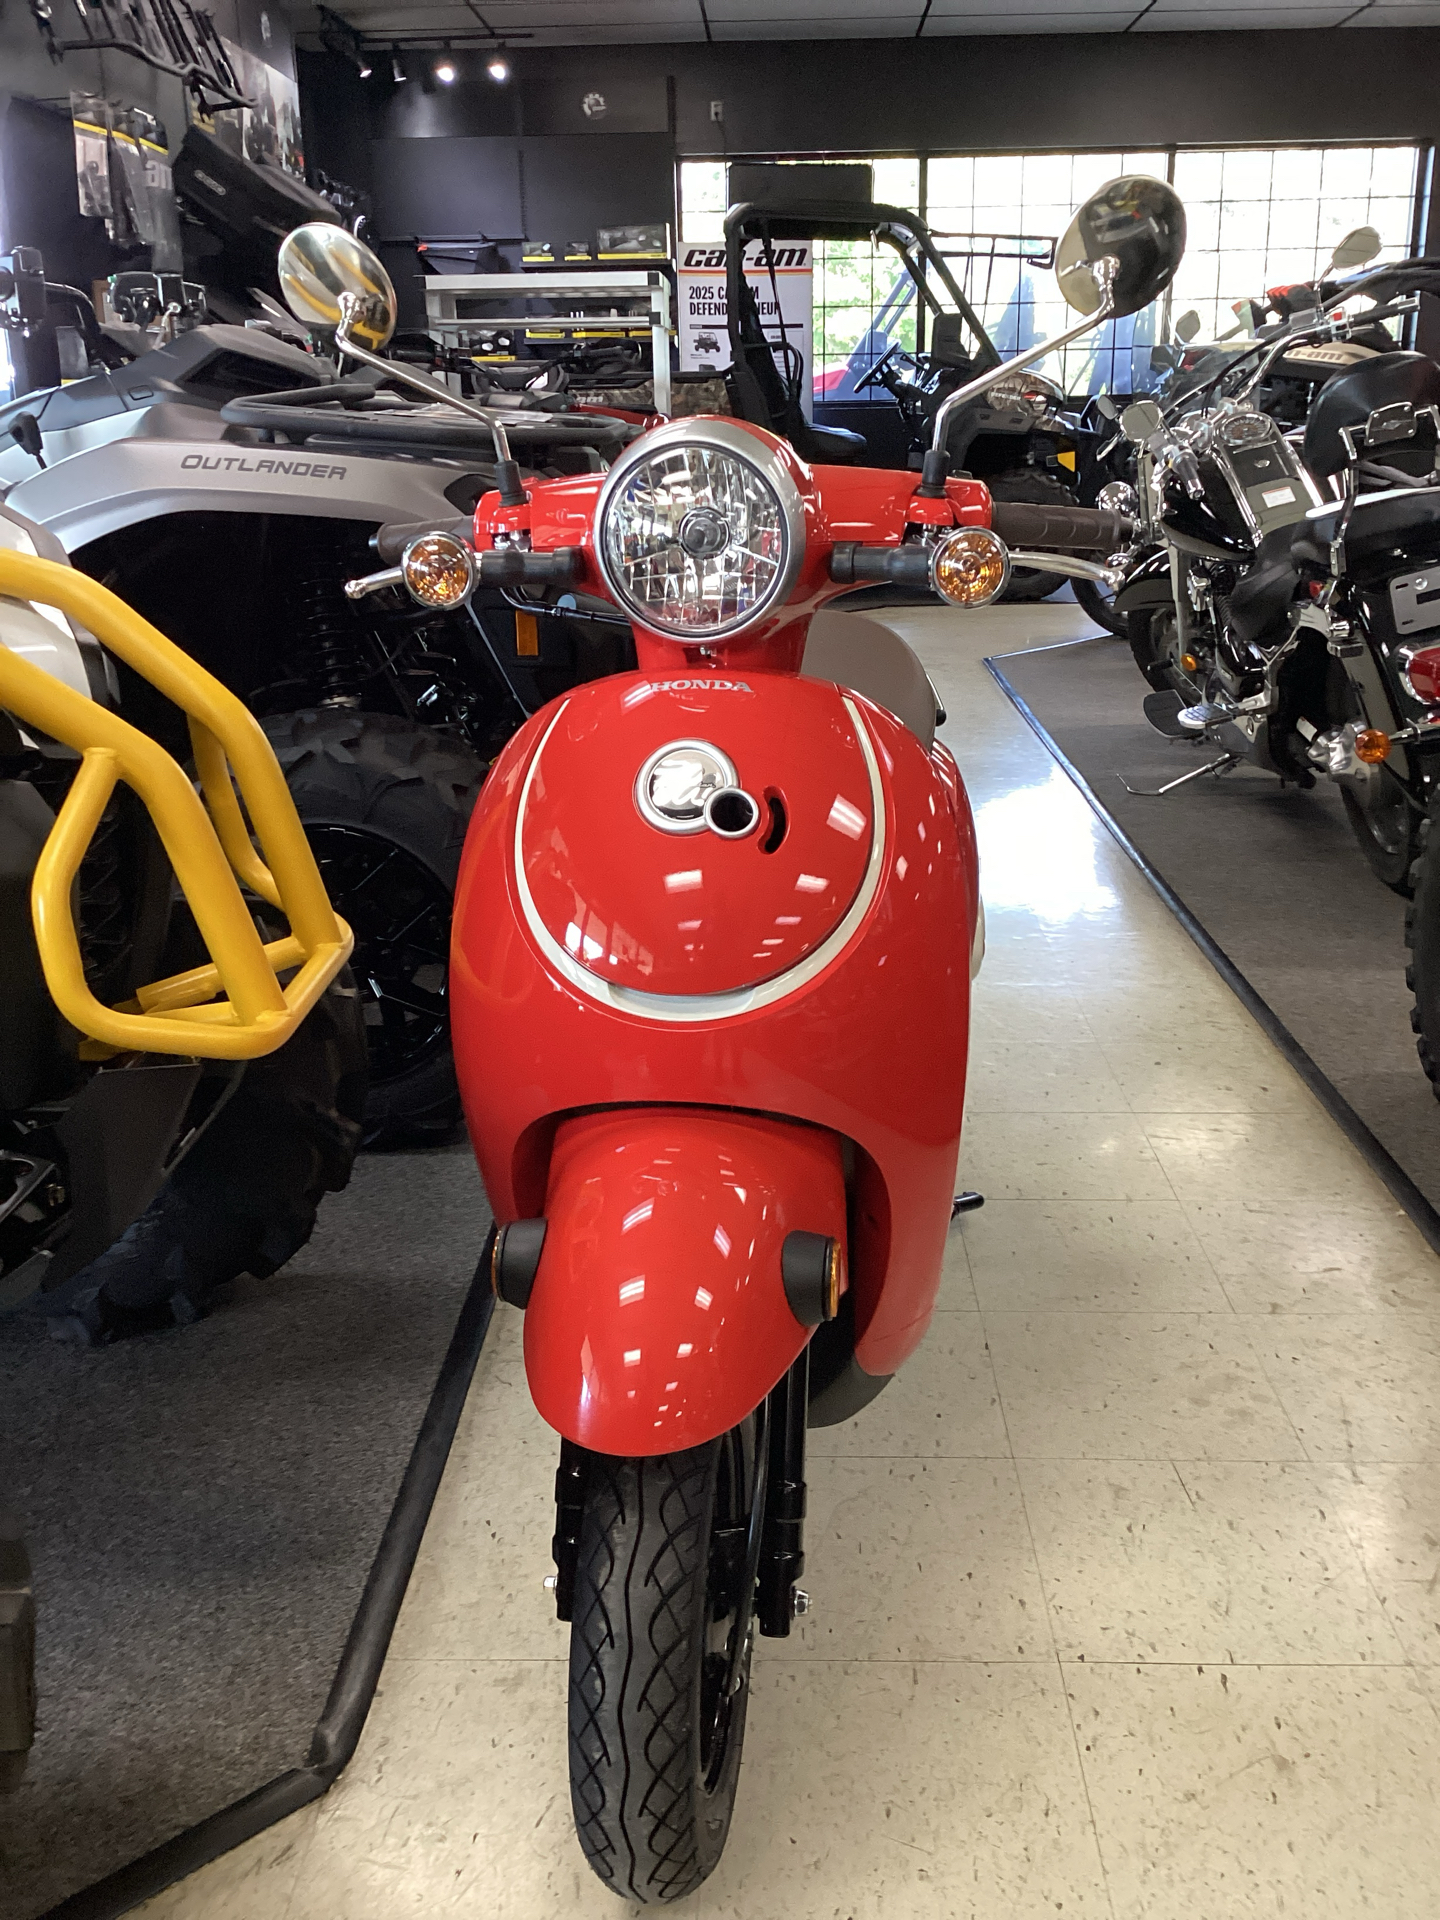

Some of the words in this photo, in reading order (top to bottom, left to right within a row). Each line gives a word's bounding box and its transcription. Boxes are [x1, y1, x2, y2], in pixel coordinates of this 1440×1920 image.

[683, 248, 808, 267] ca-am
[689, 286, 714, 299] 2025
[689, 302, 728, 315] DEFEND
[1285, 350, 1344, 360] n-am
[180, 454, 348, 480] OUTLANDER
[650, 679, 755, 693] HONDA
